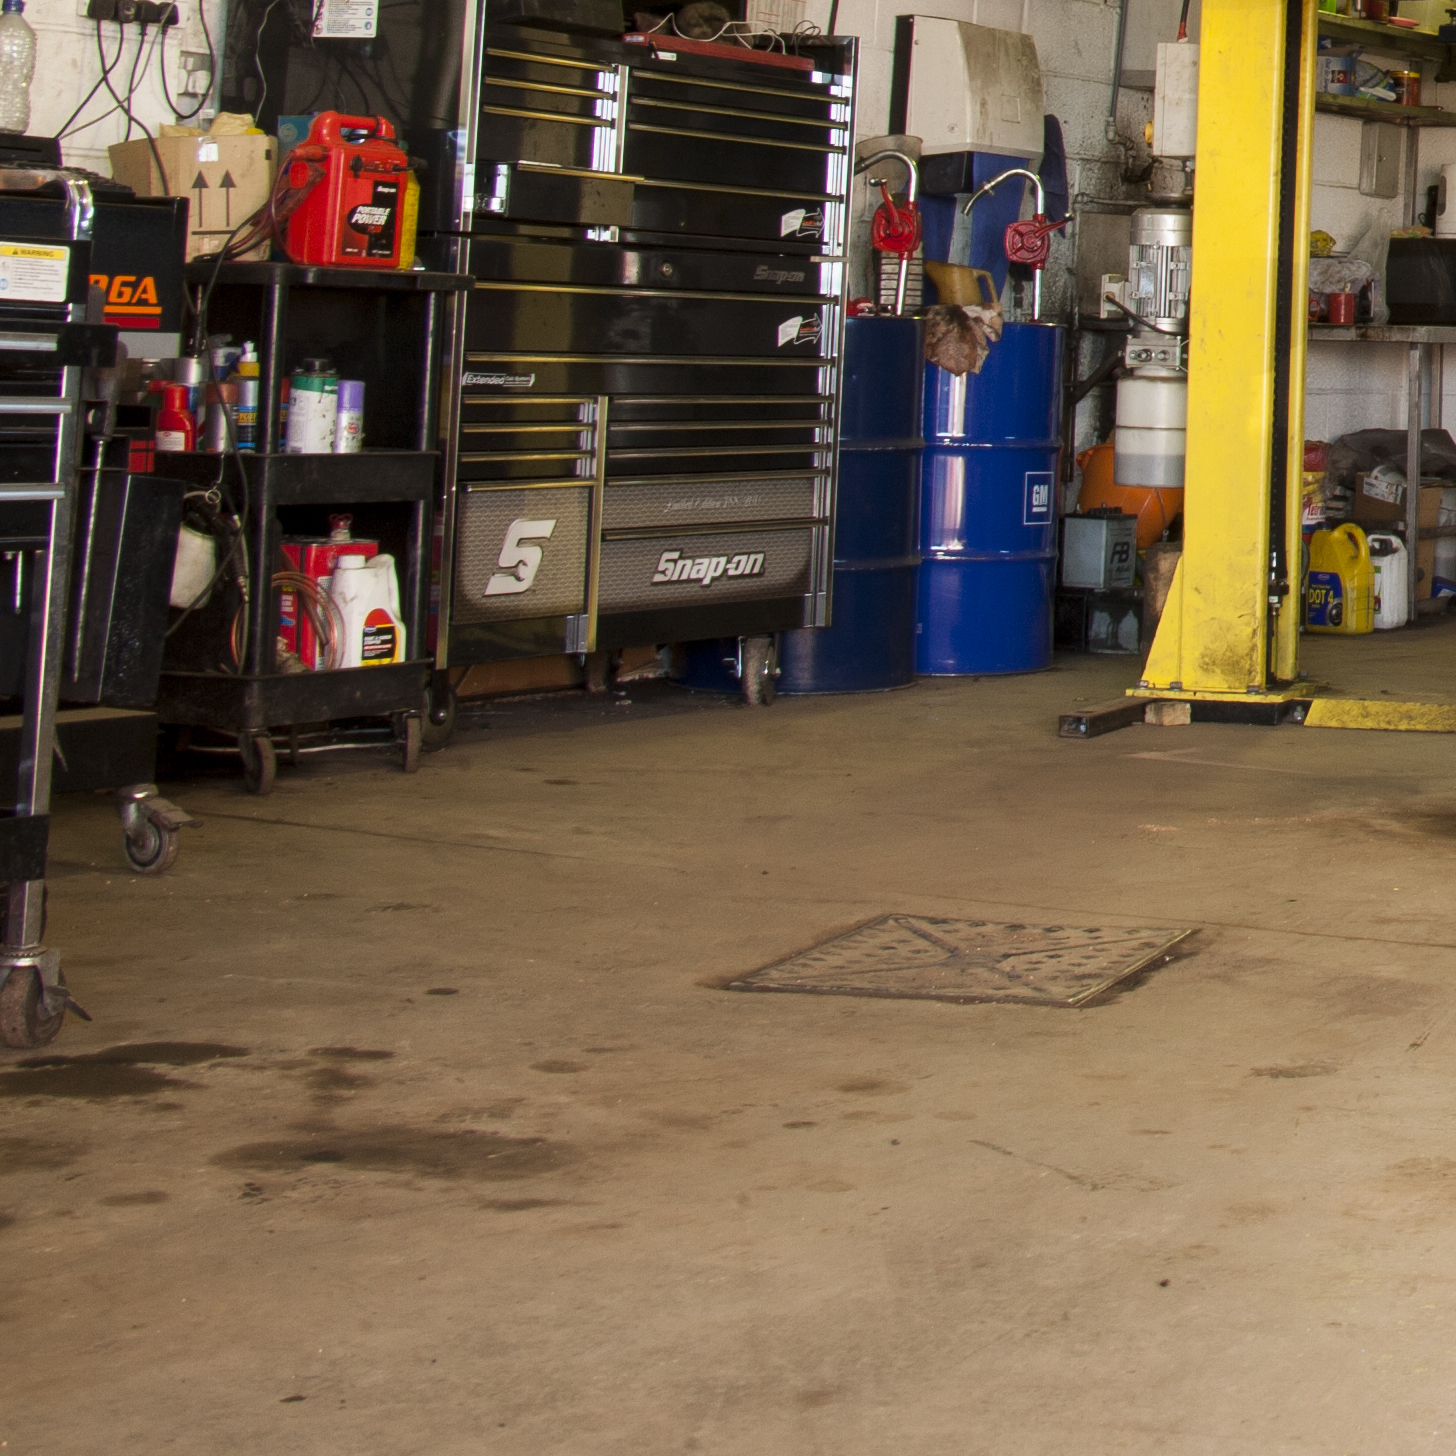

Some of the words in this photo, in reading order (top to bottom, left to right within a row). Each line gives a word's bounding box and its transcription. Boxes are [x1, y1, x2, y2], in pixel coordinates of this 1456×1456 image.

[351, 213, 388, 226] POWER
[753, 265, 805, 285] Snap-on
[1033, 484, 1049, 505] GM
[651, 551, 765, 586] Snap-on
[1309, 589, 1326, 604] DOT
